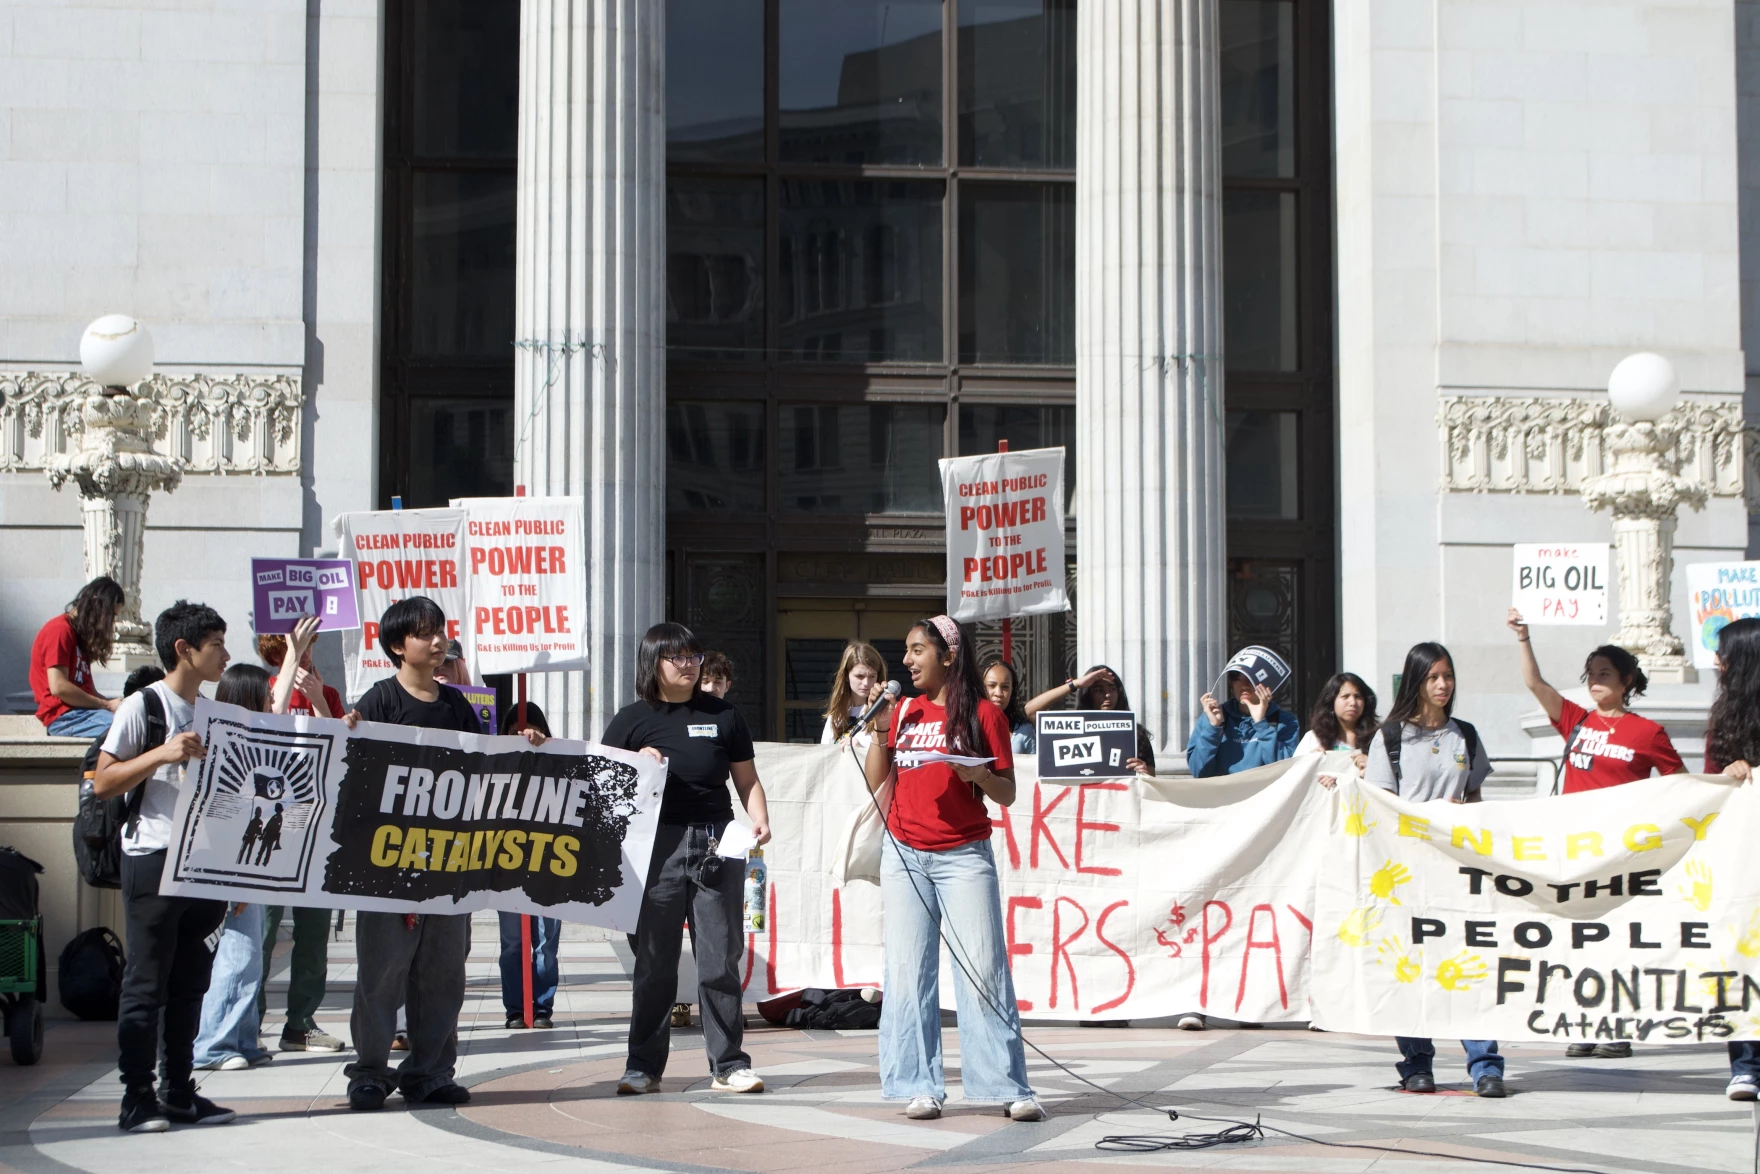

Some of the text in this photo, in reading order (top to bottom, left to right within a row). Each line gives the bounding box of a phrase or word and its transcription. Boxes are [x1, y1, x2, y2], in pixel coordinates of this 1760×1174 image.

[959, 473, 1047, 497] CLEAN PUBLIC
[960, 496, 1046, 531] POWER
[468, 519, 565, 536] CLEAN PUBLIC
[893, 528, 927, 539] PLAZA
[355, 533, 455, 550] CLEAN PUBLIC
[989, 534, 1021, 547] TO THE
[471, 546, 566, 576] POWER
[1538, 547, 1579, 559] make
[795, 560, 928, 580] CITY HALL
[963, 547, 1047, 583] PEOPLE
[259, 569, 345, 586] MAKE BIG OIL
[358, 560, 457, 590] POWER
[1520, 565, 1604, 591] BIG OIL
[1718, 567, 1757, 584] MAKE
[502, 584, 537, 596] TO THE
[961, 579, 1052, 598] PG&E is Killing Us for Profit
[273, 595, 309, 614] PAY
[1543, 597, 1579, 619] PAY
[475, 605, 571, 635] PEOPLE
[477, 642, 576, 653] G&E is Killing Us for Profit
[362, 659, 391, 668] PG&E is
[900, 721, 943, 736] MAKE
[1044, 720, 1131, 731] MAKE POLLUTERS
[1058, 742, 1095, 761] PAY
[379, 764, 591, 828] FRONTLINE
[991, 782, 1130, 877] AKE
[1398, 812, 1720, 862] ENERGY
[369, 824, 581, 878] CATALYSTS
[1459, 866, 1664, 904] TO THE
[1412, 916, 1712, 949] PEOPLE
